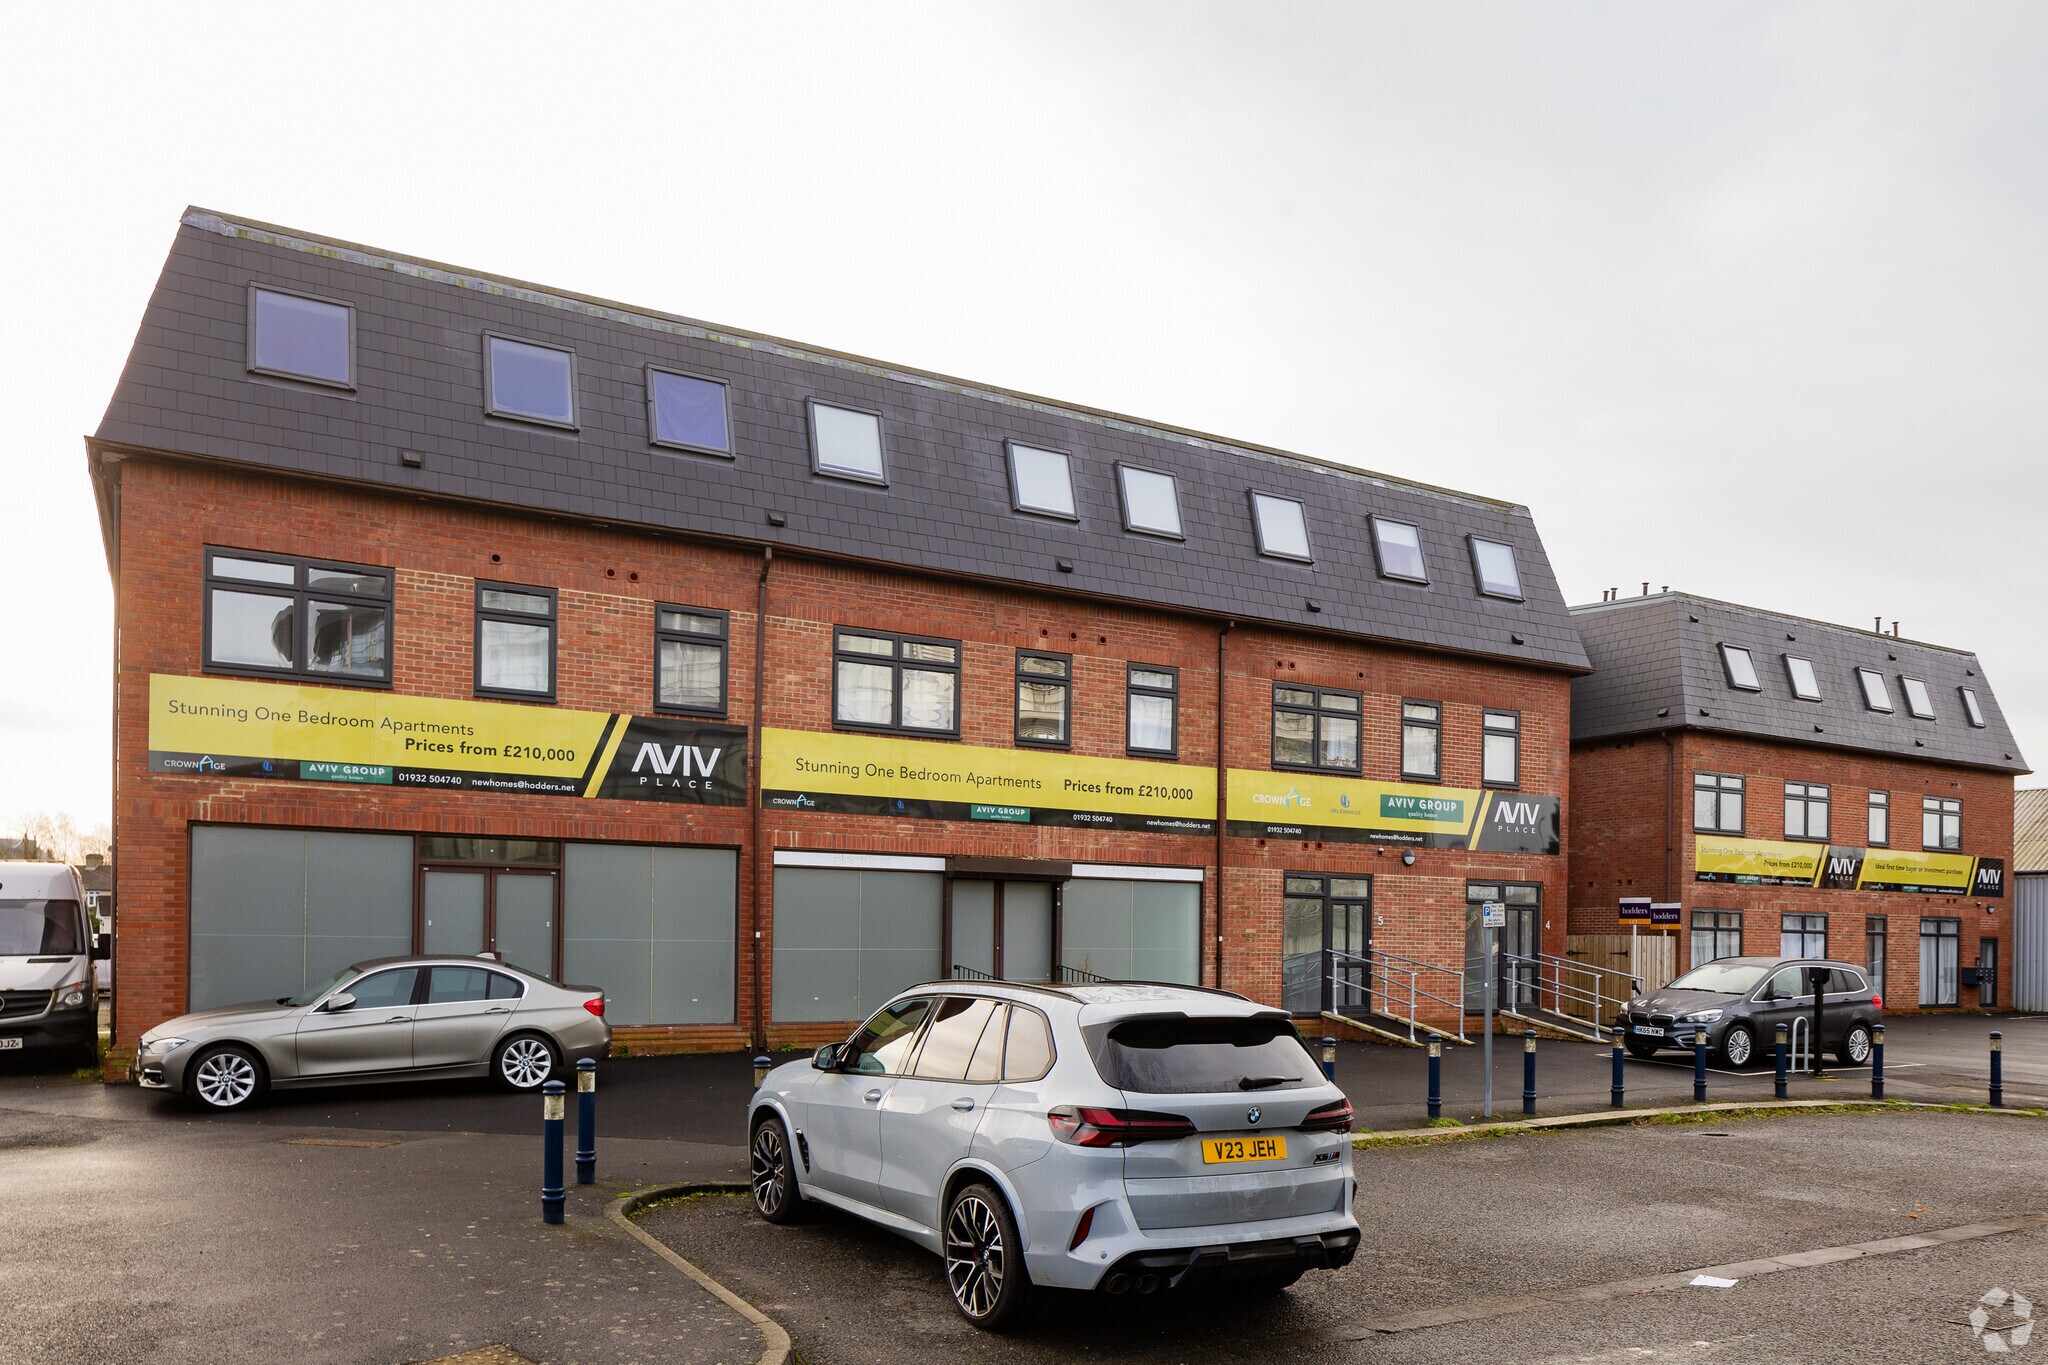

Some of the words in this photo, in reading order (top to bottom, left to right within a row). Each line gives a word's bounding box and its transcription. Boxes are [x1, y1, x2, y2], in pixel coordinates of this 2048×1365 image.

[168, 700, 249, 722] Stunning
[255, 706, 291, 722] One
[298, 710, 374, 728] Bedroom
[380, 717, 474, 736] Apartments
[404, 738, 454, 754] Prices
[460, 741, 498, 756] from
[503, 745, 575, 762] £210,000
[631, 742, 722, 778] AVIV
[308, 764, 338, 775] AVIV
[343, 766, 386, 776] GROUP
[796, 758, 860, 778] Stunning
[865, 764, 894, 778] One
[900, 766, 962, 784] Bedroom
[966, 772, 1042, 789] Apartments
[398, 772, 427, 783] 01932
[429, 774, 462, 786] 504740
[472, 777, 575, 792] newhomes@hodders.net
[640, 776, 712, 790] PLACE
[1064, 778, 1100, 793] Prices
[1105, 782, 1134, 796] from
[1138, 785, 1193, 800] £210,000
[1388, 798, 1415, 808] AVIV
[1418, 800, 1457, 812] GROUP
[998, 808, 1026, 816] GROUP
[1494, 801, 1540, 825] AVIV
[1072, 814, 1091, 822] 01932
[1092, 814, 1113, 823] 504740
[1146, 820, 1211, 830] newhomes@hodders.net
[1498, 826, 1536, 834] PLACE
[1370, 834, 1423, 842] newhomes@hodders.net
[833, 855, 890, 867] electrical
[1779, 860, 1790, 868] from
[1791, 861, 1812, 870] £210,000
[1102, 866, 1165, 878] wholesalers
[1484, 907, 1490, 916] P
[1622, 906, 1648, 914] hodders
[1378, 916, 1383, 925] 5
[1545, 920, 1551, 930] 4
[1214, 1141, 1244, 1160] V23
[1249, 1139, 1277, 1158] JEH
